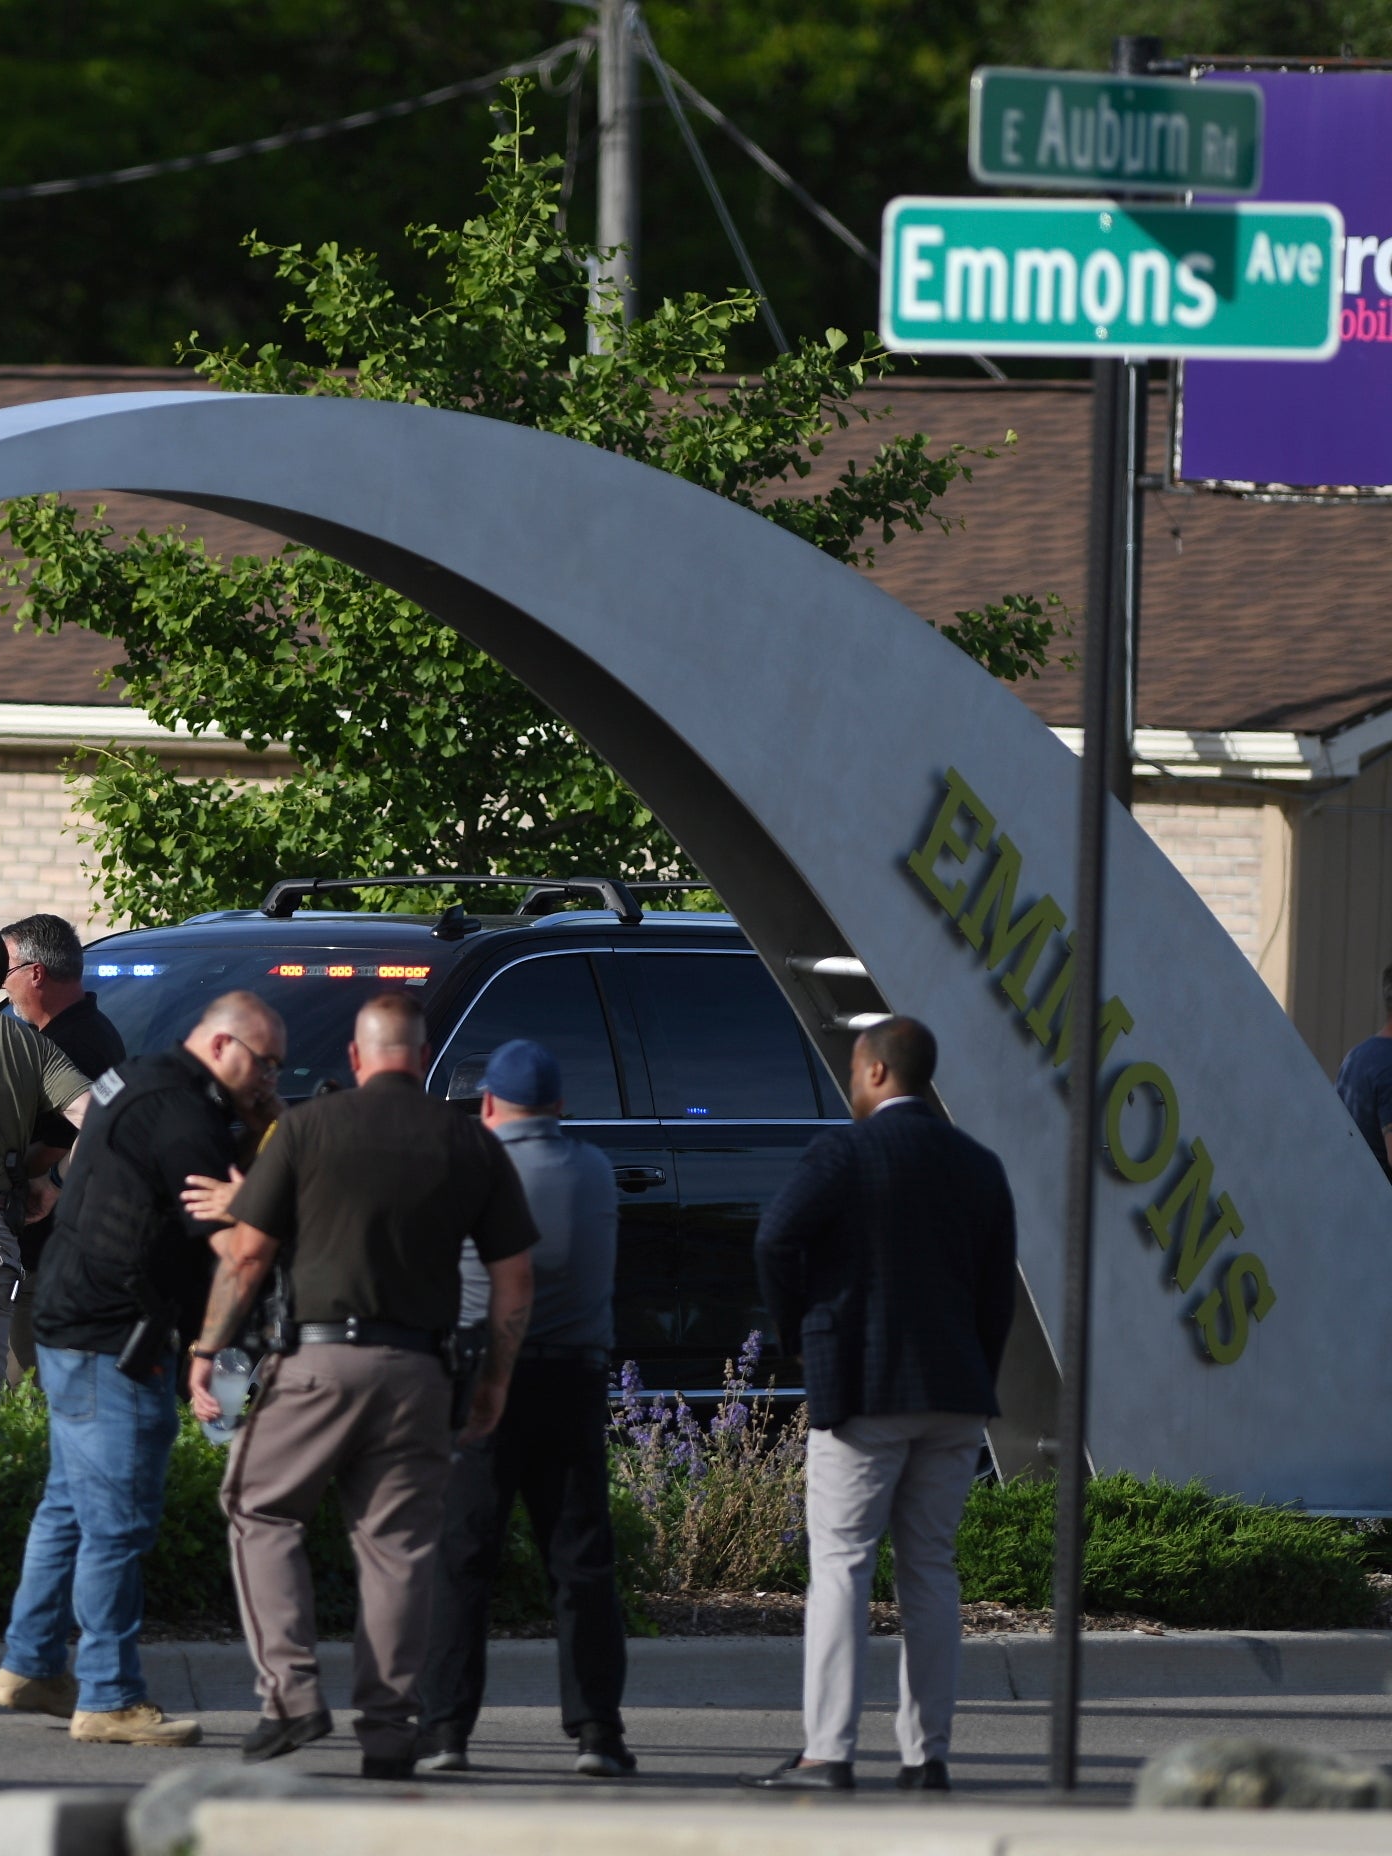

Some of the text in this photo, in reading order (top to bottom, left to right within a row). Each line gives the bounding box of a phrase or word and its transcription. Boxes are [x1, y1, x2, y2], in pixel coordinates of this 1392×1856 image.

[1001, 87, 1238, 178] E Auburn Rd
[899, 225, 1323, 329] Emmons Ave
[908, 766, 1277, 1365] EMMONS
